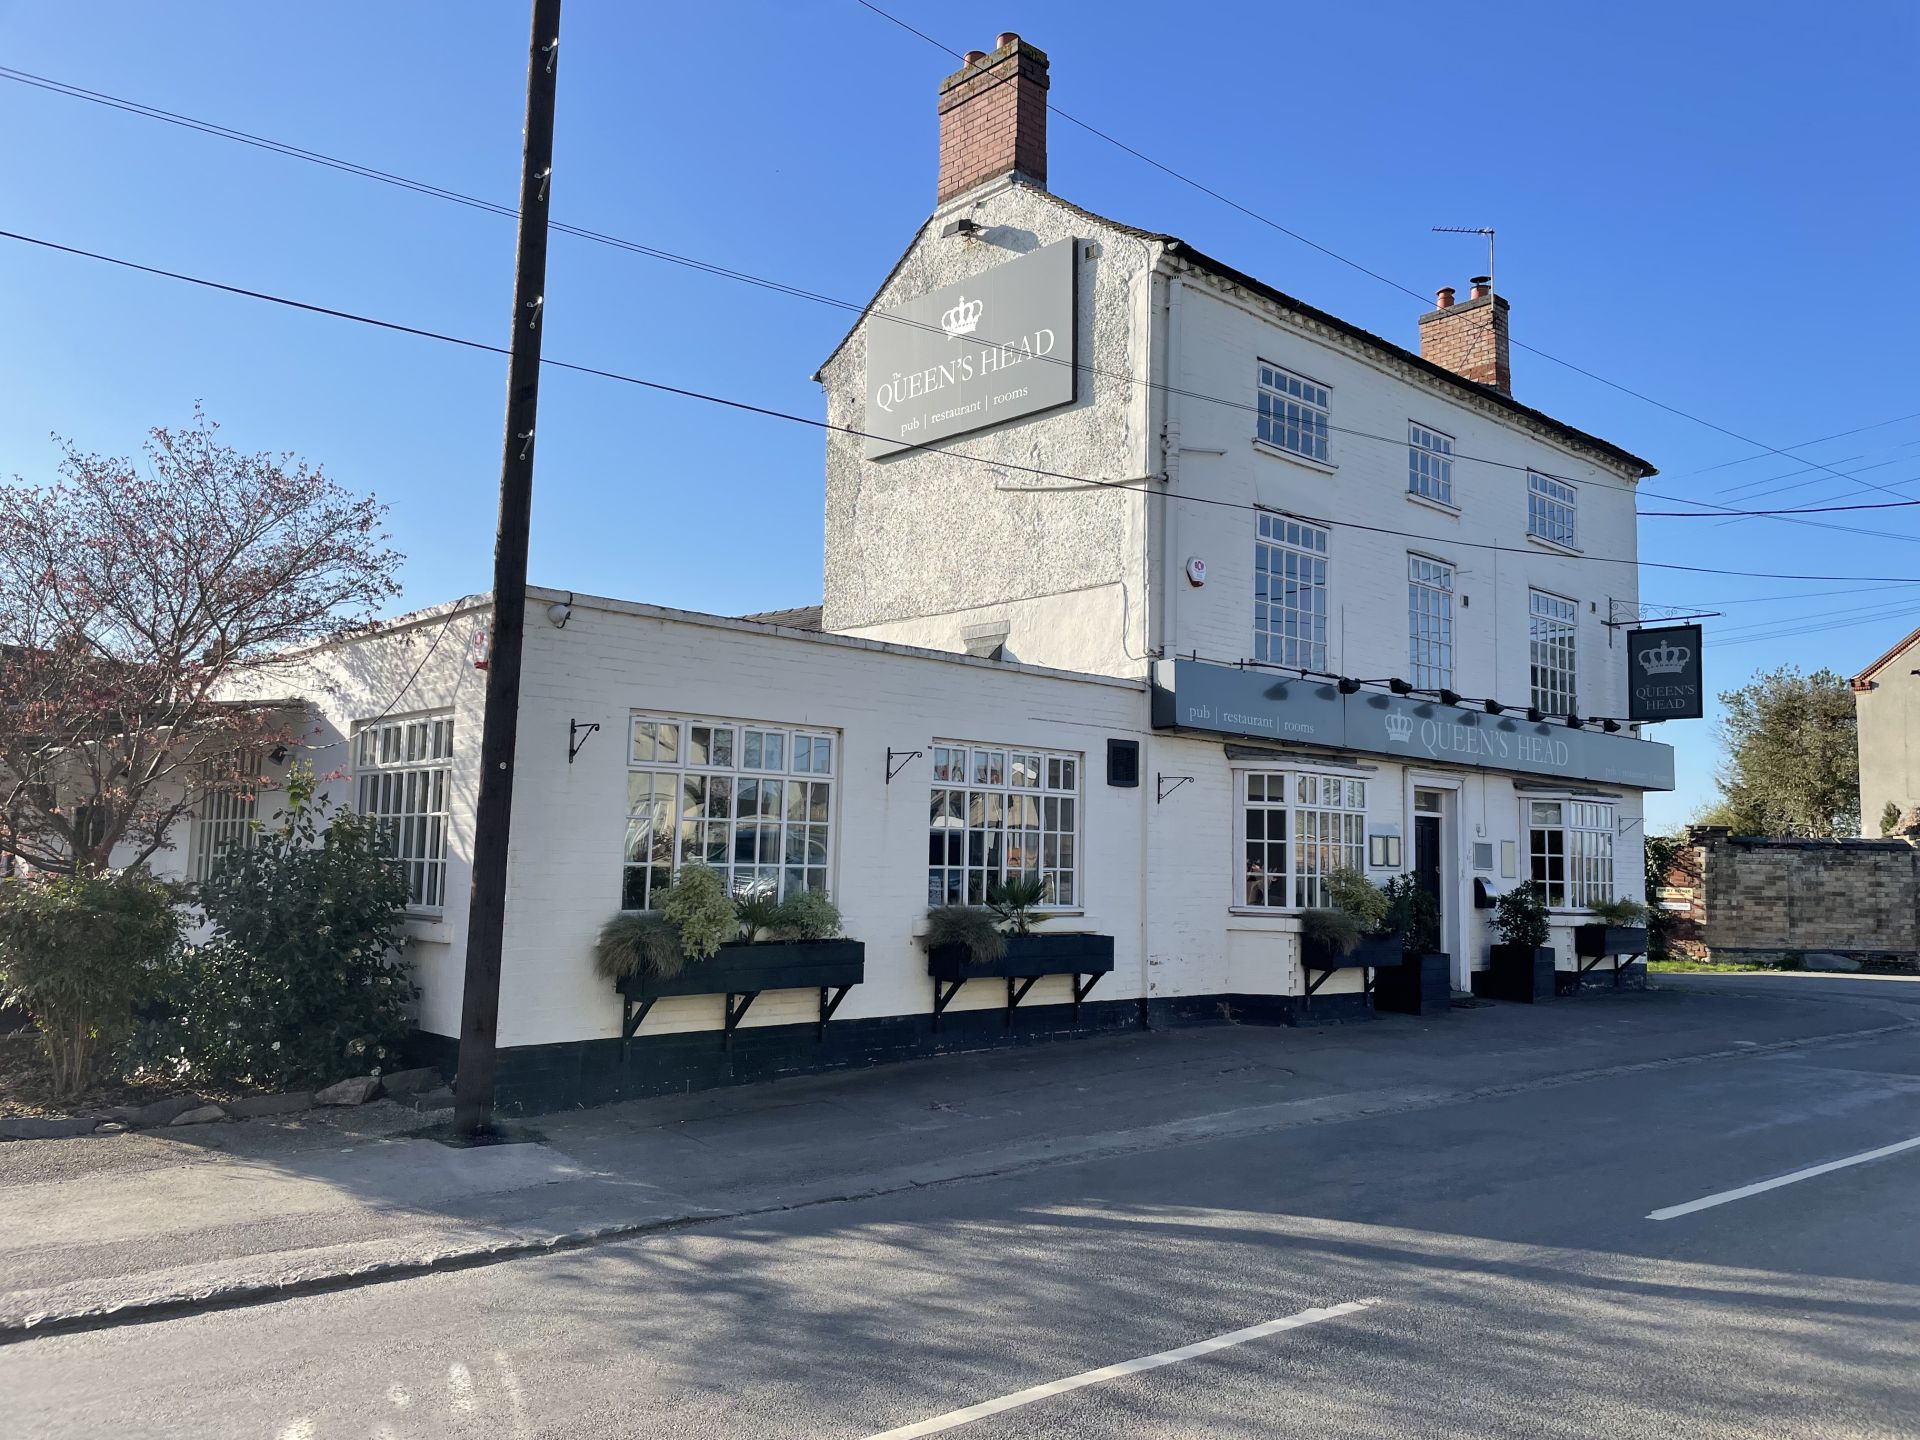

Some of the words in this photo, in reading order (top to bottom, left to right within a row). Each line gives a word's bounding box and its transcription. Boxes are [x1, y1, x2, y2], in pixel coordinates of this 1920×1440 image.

[876, 355, 974, 412] QUEEN'S
[980, 329, 1055, 376] HEAD
[892, 372, 902, 380] The
[901, 418, 920, 437] pub
[931, 401, 981, 424] restaurant
[993, 386, 1028, 406] rooms
[1635, 684, 1696, 700] QUEEN'S
[1646, 698, 1686, 711] HEAD
[1189, 705, 1211, 722] pub
[1223, 711, 1273, 729] restaurant
[1284, 720, 1315, 735] rooms
[1420, 719, 1509, 758] QUEEN'S
[1517, 735, 1569, 767] HEAD
